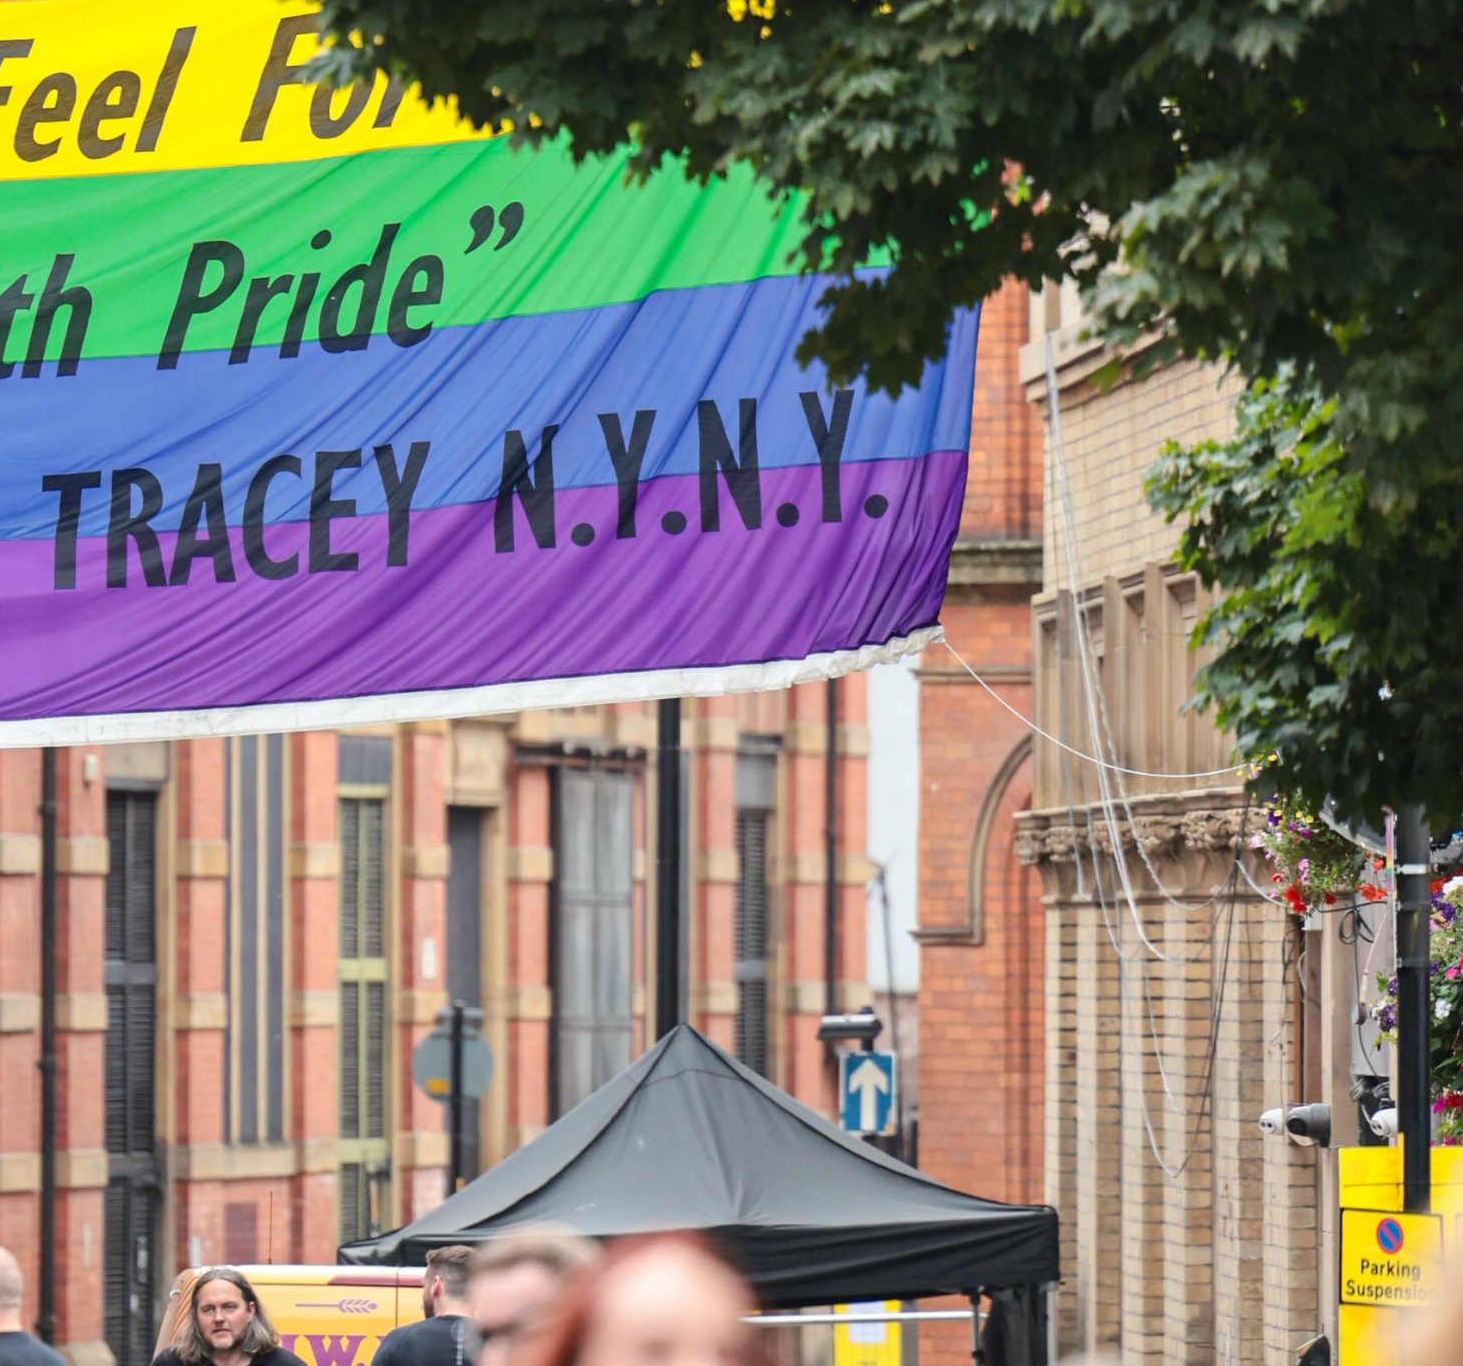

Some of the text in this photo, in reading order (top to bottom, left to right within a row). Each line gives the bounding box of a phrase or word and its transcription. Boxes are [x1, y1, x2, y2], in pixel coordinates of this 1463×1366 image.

[156, 201, 525, 370] Pride”
[42, 389, 890, 590] TRACEY N.Y.N.Y.
[1360, 1258, 1421, 1282] Parking
